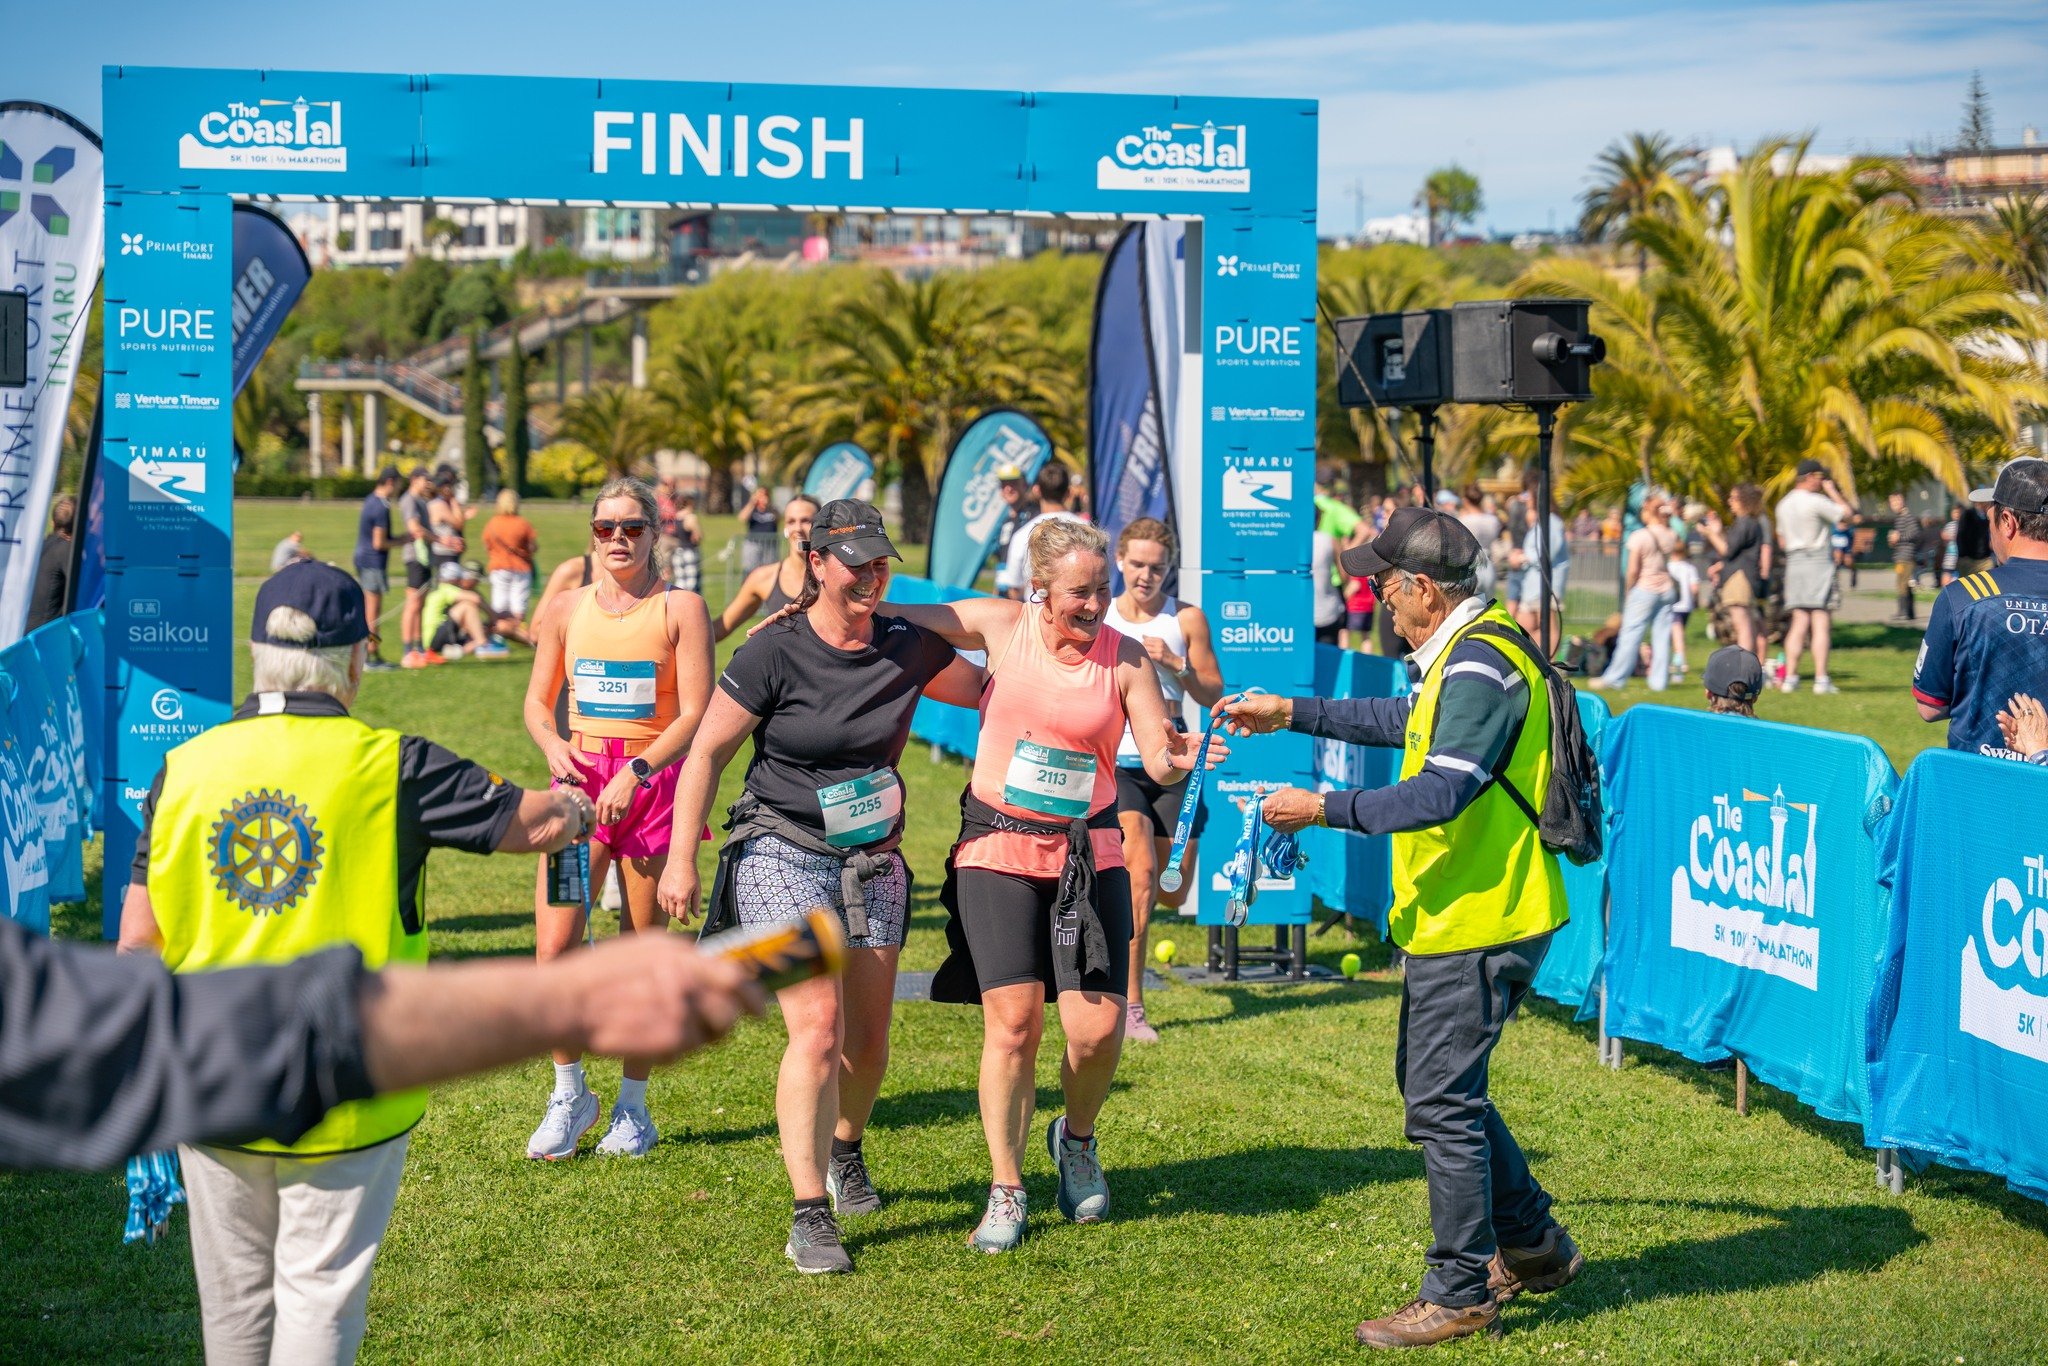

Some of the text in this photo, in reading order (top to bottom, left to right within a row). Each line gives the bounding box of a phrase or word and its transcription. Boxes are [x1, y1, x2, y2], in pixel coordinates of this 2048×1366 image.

[228, 102, 260, 118] The
[199, 97, 342, 146] Coastal
[1116, 121, 1246, 167] Coastal
[1142, 126, 1172, 142] The
[593, 110, 864, 180] FINISH
[230, 155, 242, 163] 5K
[251, 155, 268, 163] 10K
[289, 156, 341, 165] MARATHON
[1197, 178, 1245, 186] MARATHON
[46, 262, 78, 389] TIMARU
[120, 308, 214, 339] PURE
[120, 342, 215, 353] SPORTS NUTRITION
[1216, 326, 1300, 355] PURE
[1252, 359, 1300, 367] NUTRITION
[134, 394, 220, 406] Venture Timaru
[1228, 407, 1305, 417] Venture Timaru
[129, 445, 206, 458] TIMARU
[1223, 456, 1293, 467] TIMARU
[129, 621, 208, 643] saikou
[1221, 622, 1294, 644] saikou
[598, 681, 628, 693] 3251
[130, 724, 204, 734] AMERIKIWI
[1037, 769, 1067, 786] 2113
[1190, 750, 1206, 793] COASTAL
[849, 797, 882, 817] 2255
[1184, 793, 1195, 814] RUN
[1713, 793, 1743, 832] The
[1243, 819, 1254, 840] RUN
[1689, 786, 1818, 919] Coastal
[1714, 924, 1725, 943] 5K
[2017, 1012, 2035, 1037] 5K
